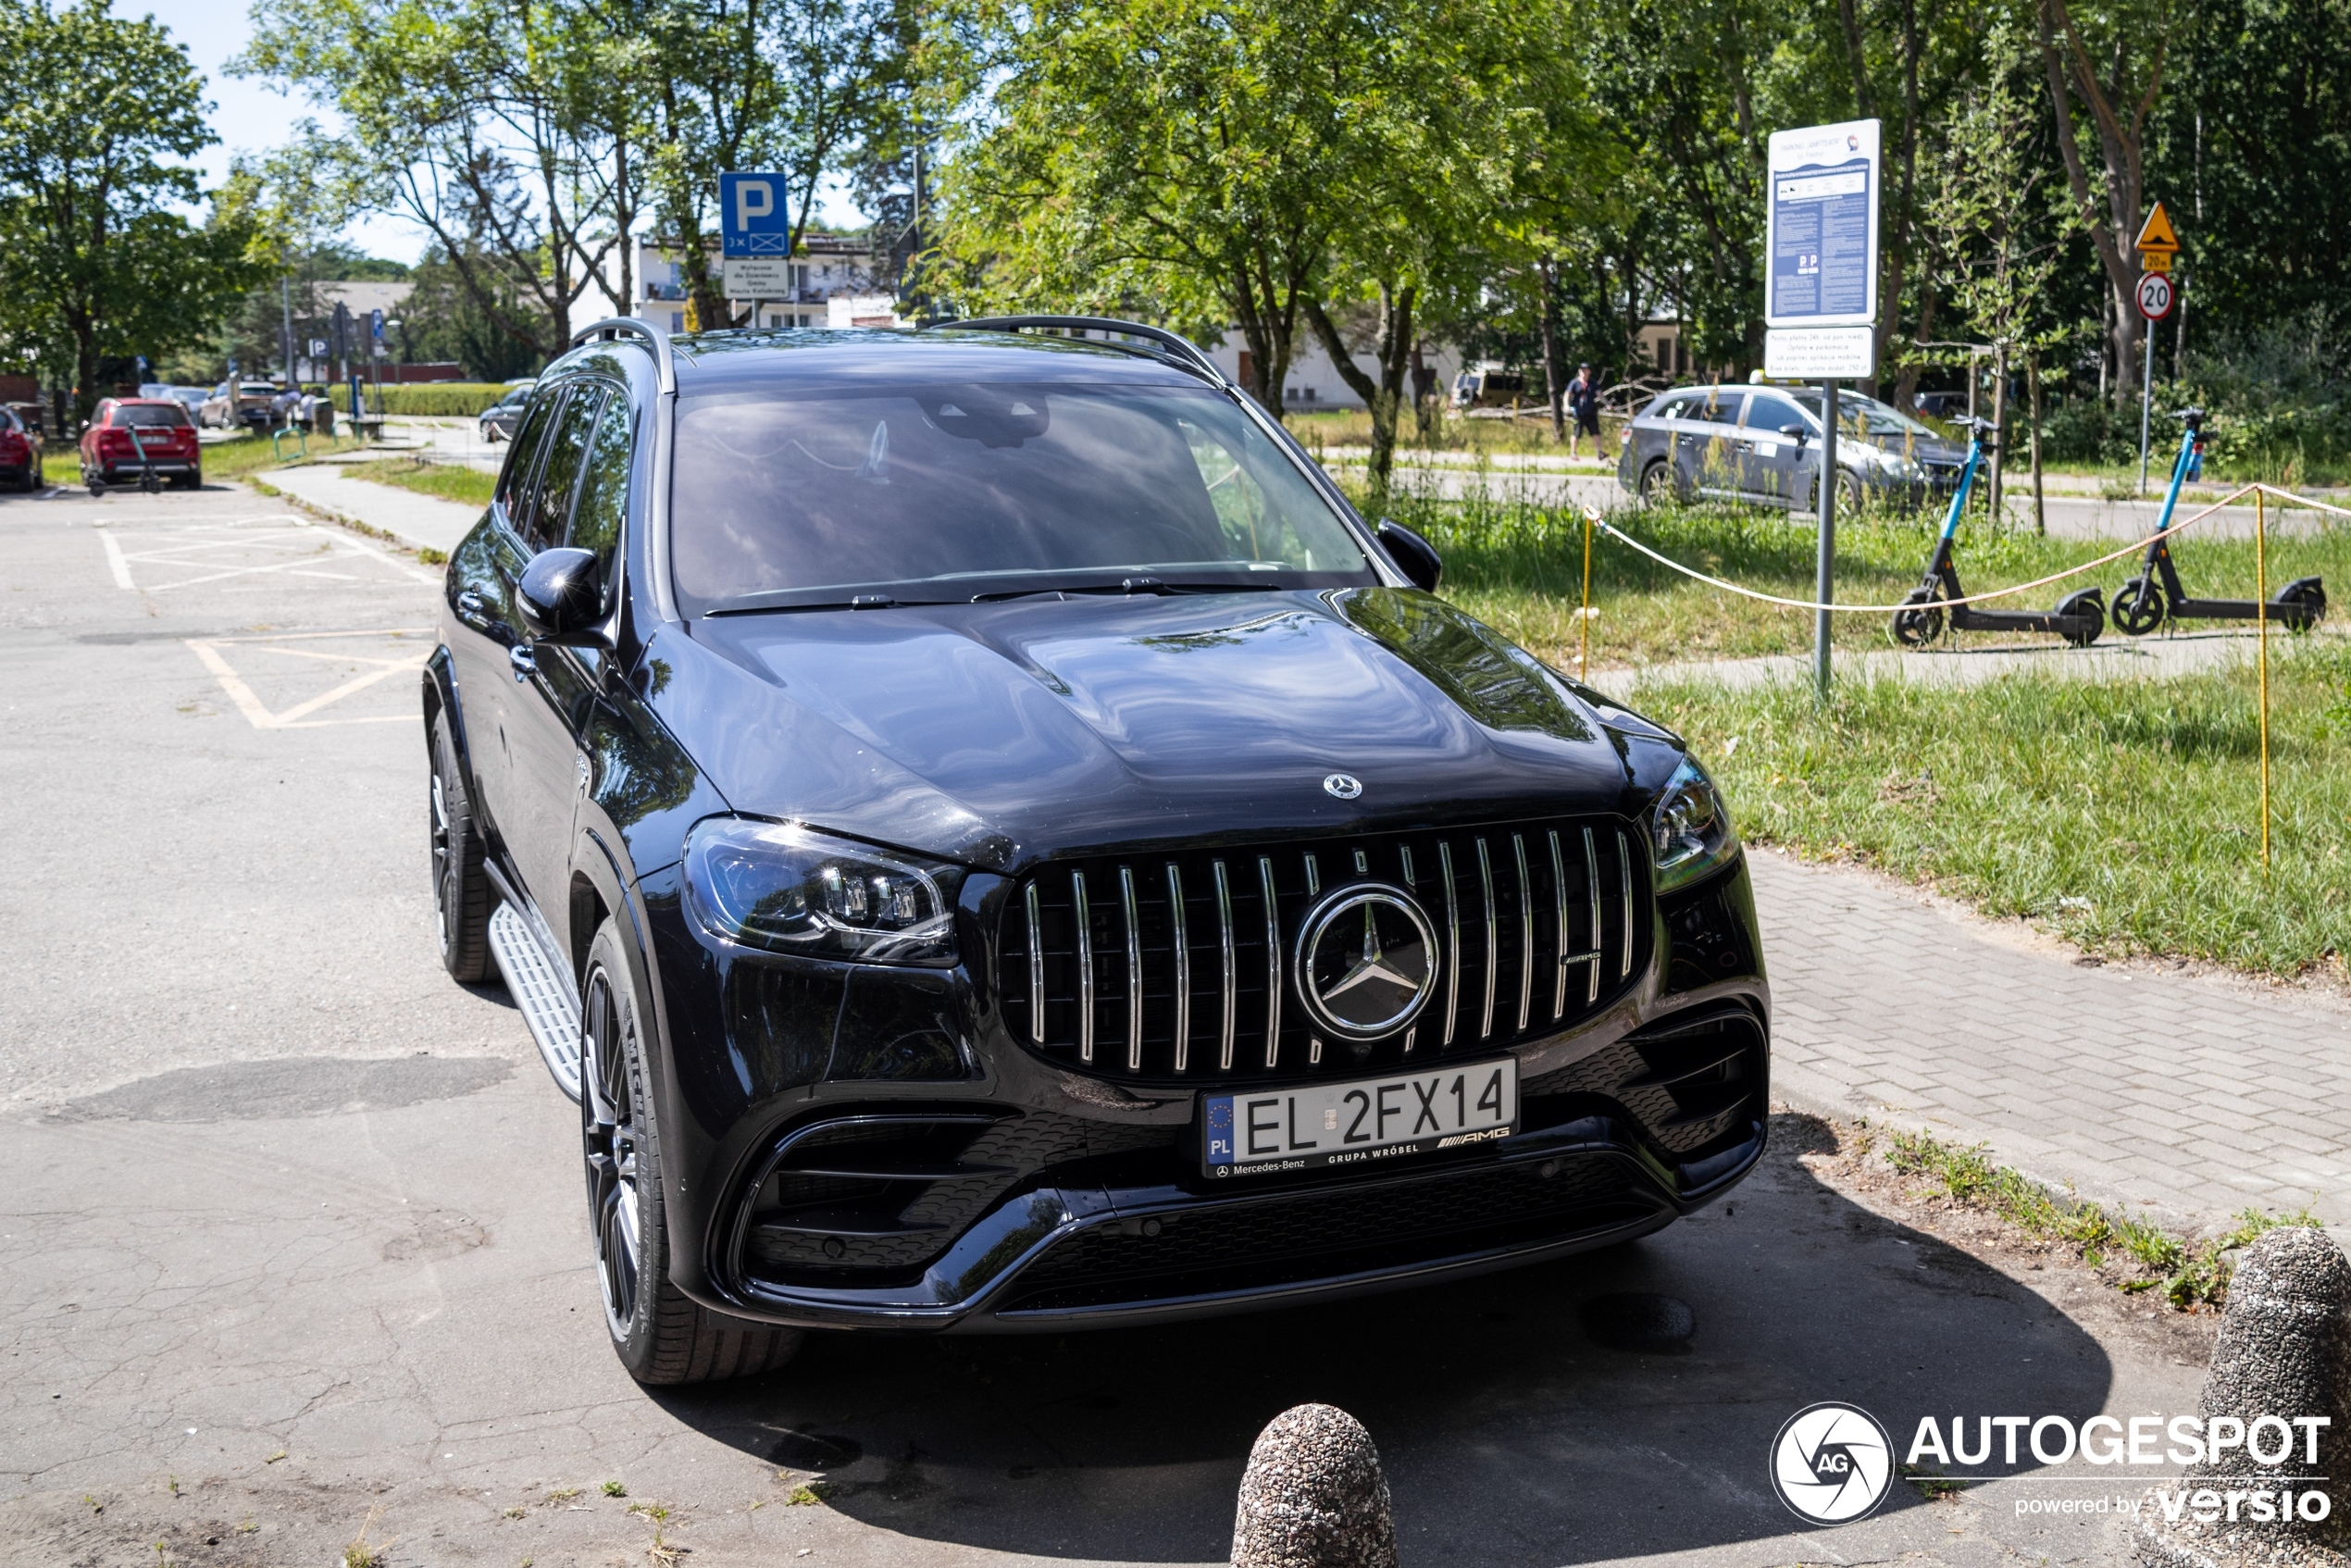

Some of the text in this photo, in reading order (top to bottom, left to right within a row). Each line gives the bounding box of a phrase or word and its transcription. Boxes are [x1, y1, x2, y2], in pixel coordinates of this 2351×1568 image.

[736, 180, 773, 231] P
[2145, 284, 2168, 307] 20
[315, 341, 327, 355] P
[1576, 952, 1601, 963] AMG
[1248, 1069, 1501, 1156] EL 2FX14
[1461, 1126, 1510, 1145] AMG
[1211, 1139, 1230, 1155] PL
[1328, 1144, 1418, 1164] GRUPA WRÓBEL
[1233, 1160, 1305, 1175] Mercedes-Benz
